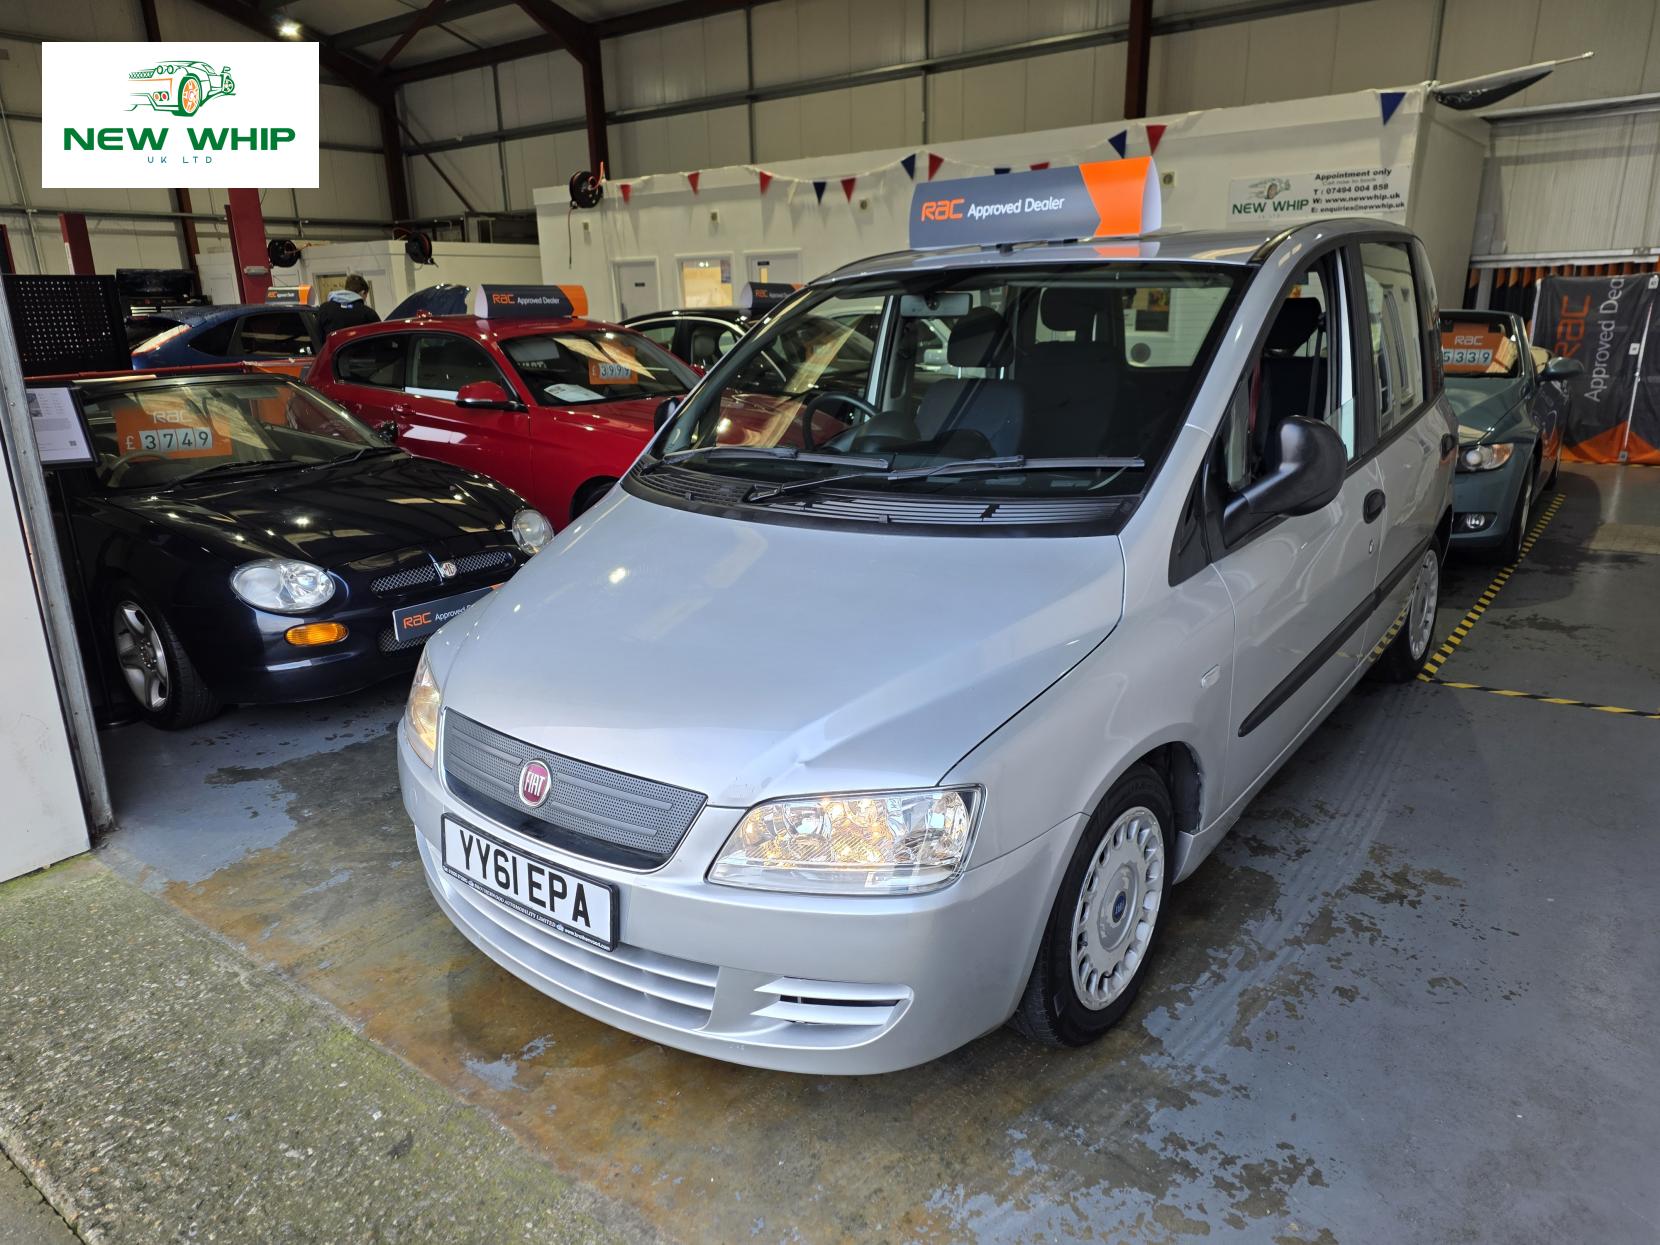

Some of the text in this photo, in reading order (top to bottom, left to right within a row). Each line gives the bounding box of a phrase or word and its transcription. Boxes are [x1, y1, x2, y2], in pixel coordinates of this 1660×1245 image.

[1315, 168, 1392, 181] Appointment only
[1326, 186, 1352, 195] 07494
[1354, 184, 1370, 192] 004
[1325, 192, 1400, 204] www.newwhip.uk
[967, 199, 1022, 221] Approved
[1024, 195, 1065, 213] Dealer
[1232, 199, 1309, 215] NEW WHIP
[517, 296, 542, 306] Approved
[543, 297, 560, 305] Dealer
[1584, 321, 1615, 402] Approved
[524, 770, 546, 797] FIAT
[459, 829, 591, 928] YY61 EPA
